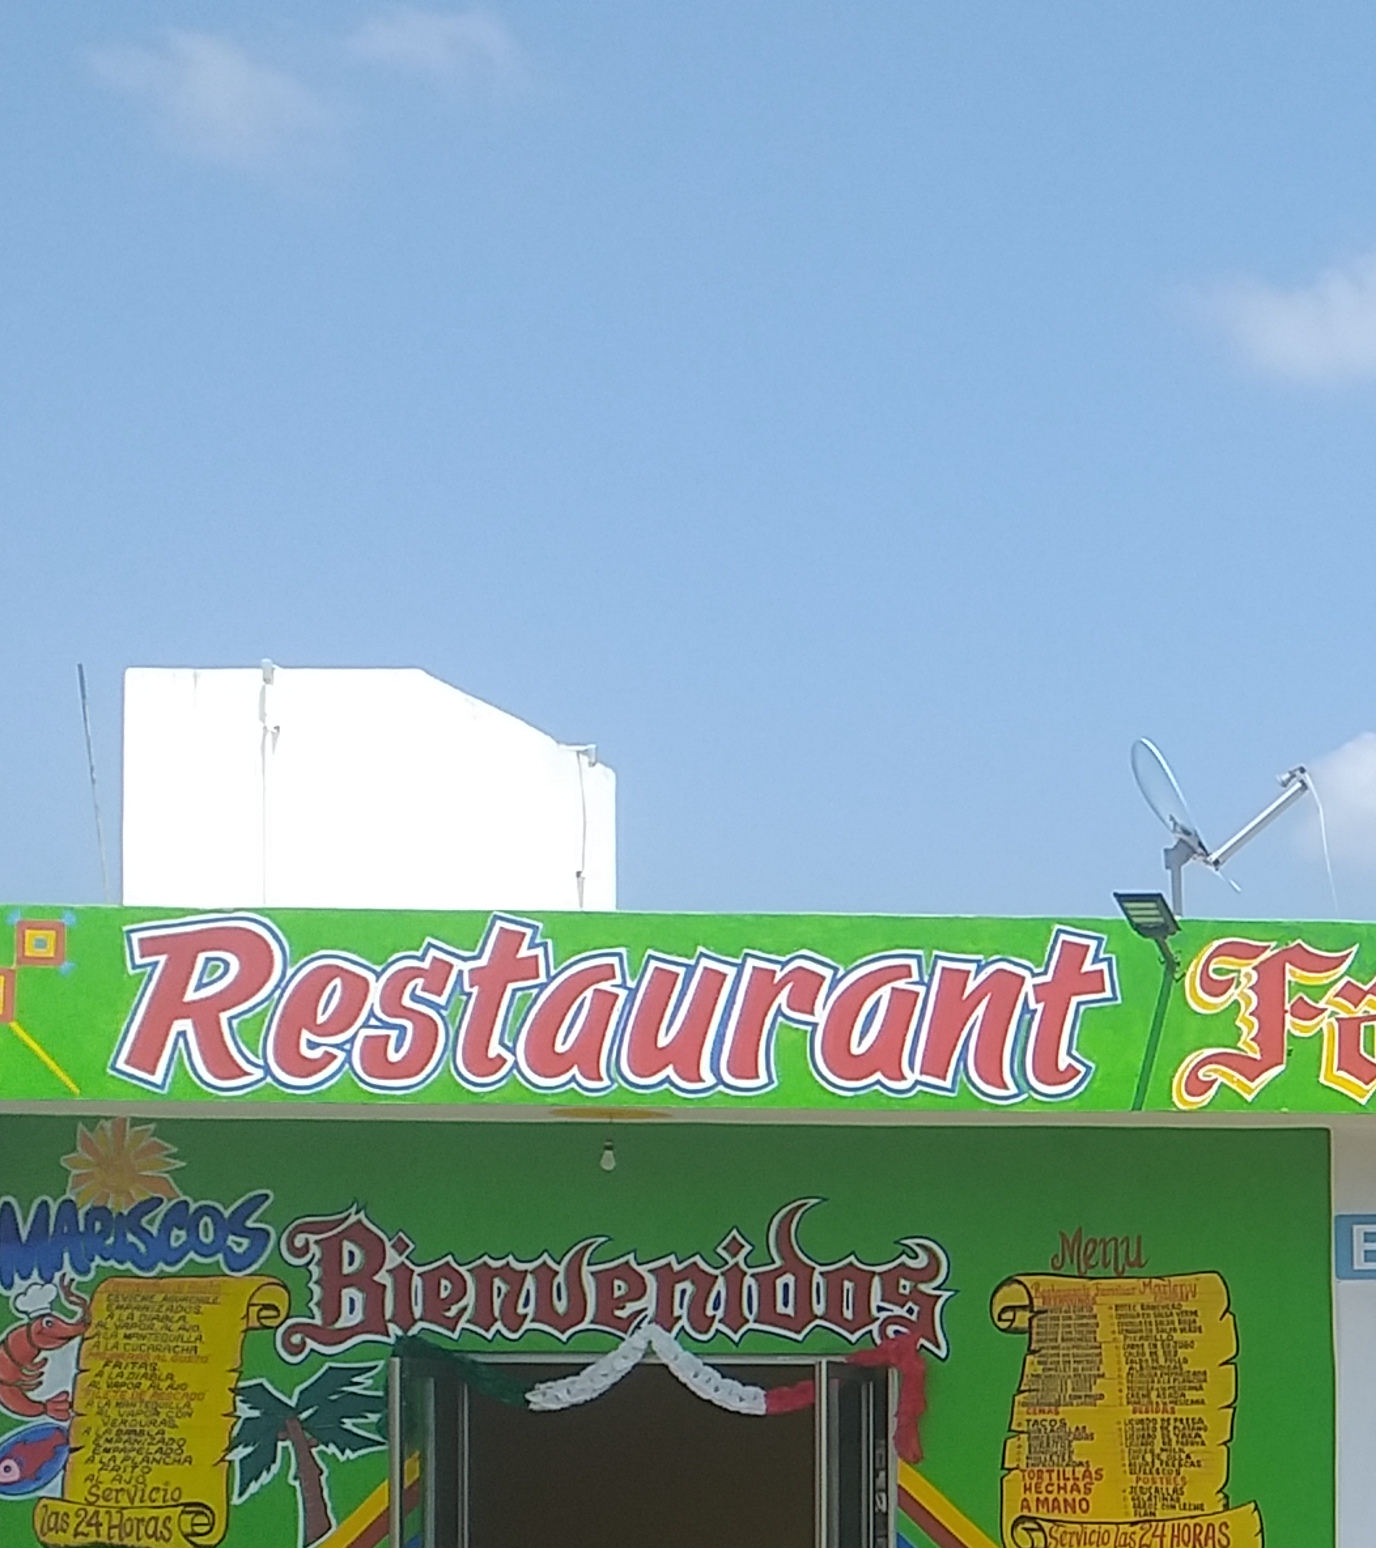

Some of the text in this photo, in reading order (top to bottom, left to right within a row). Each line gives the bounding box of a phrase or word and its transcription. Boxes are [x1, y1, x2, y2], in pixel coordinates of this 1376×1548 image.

[108, 912, 1118, 1104] Restaurant
[0, 1190, 274, 1296] MARISCOS
[1051, 1225, 1149, 1276] Menu
[273, 1196, 958, 1364] Bienvenidos
[123, 1343, 198, 1355] CUCARACHA
[1025, 1418, 1067, 1428] TACOS
[97, 1465, 152, 1475] FRITO
[120, 1456, 193, 1467] PLANCHA
[1020, 1467, 1104, 1482] TORTILLAS
[85, 1481, 182, 1506] Servicio
[1024, 1482, 1094, 1496] HECHAS
[1021, 1497, 1090, 1514] A MANO
[41, 1504, 172, 1543] las 24 Horas
